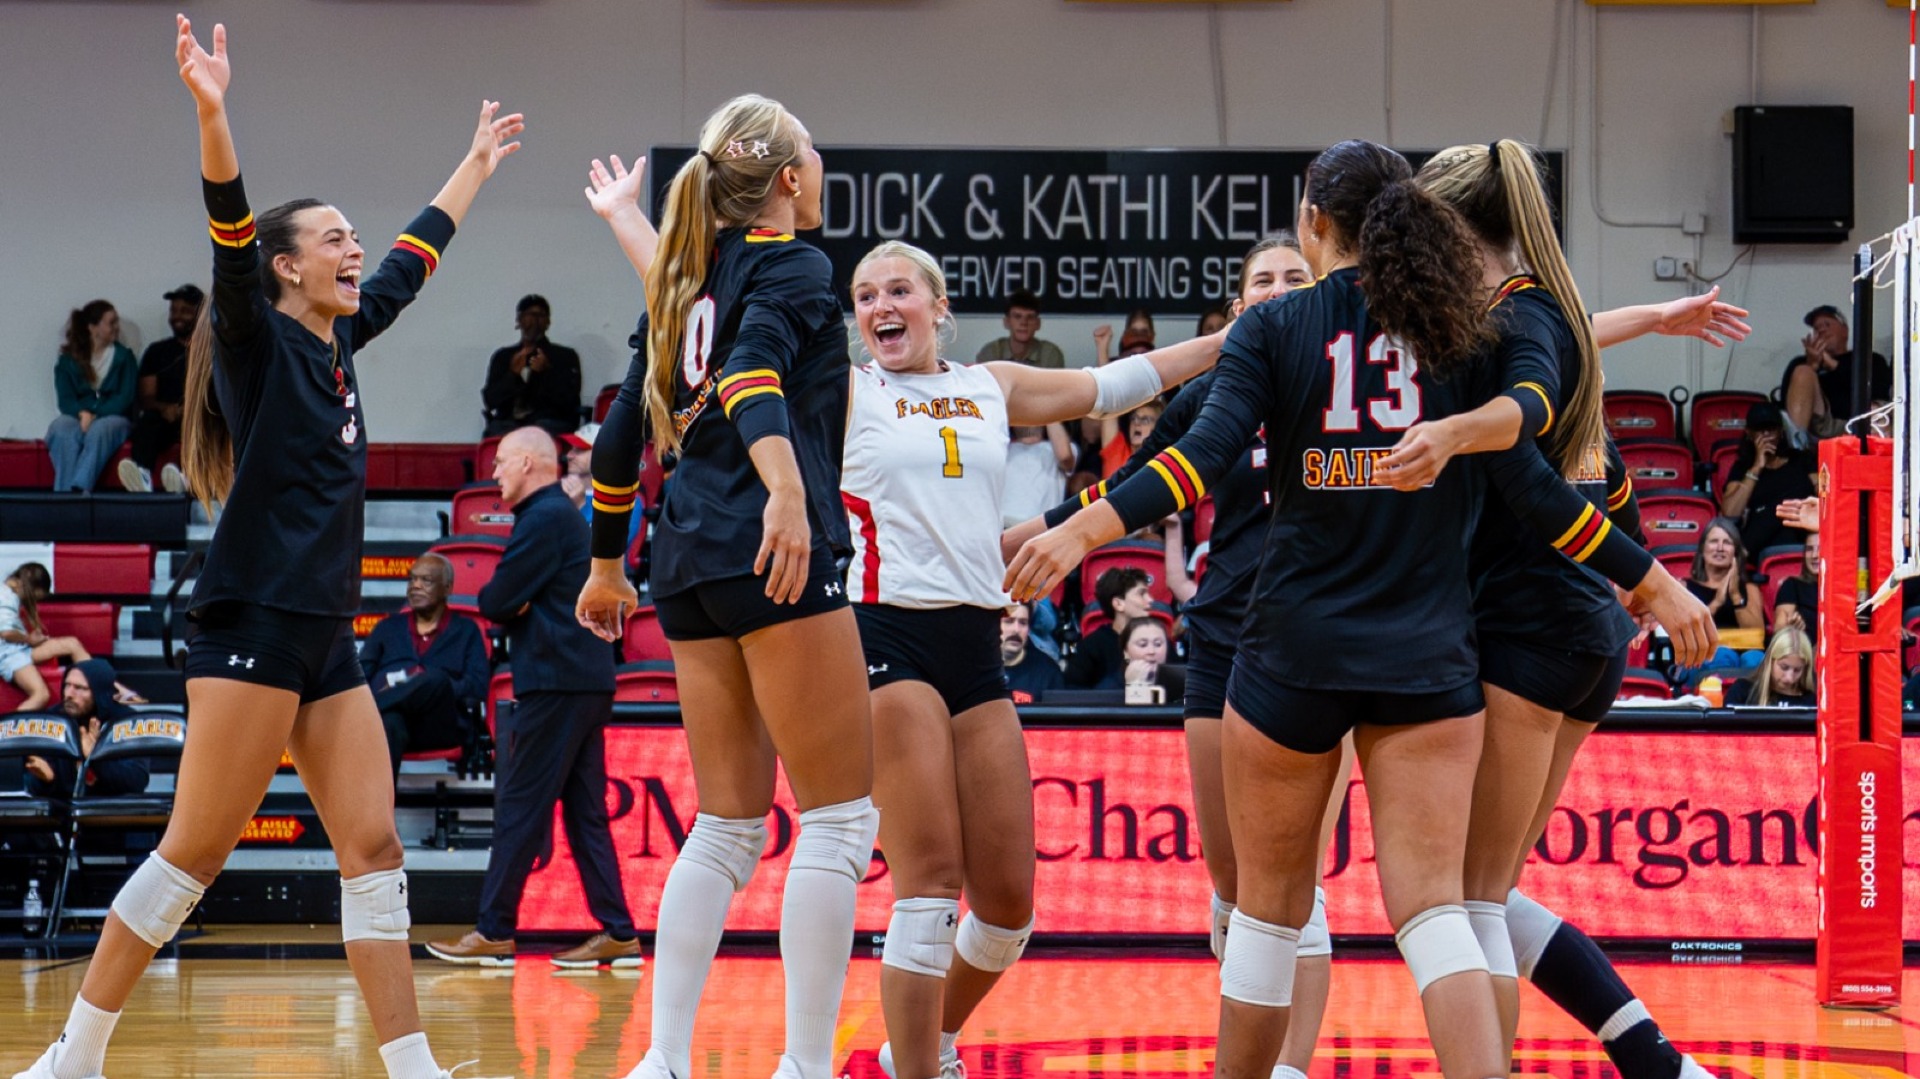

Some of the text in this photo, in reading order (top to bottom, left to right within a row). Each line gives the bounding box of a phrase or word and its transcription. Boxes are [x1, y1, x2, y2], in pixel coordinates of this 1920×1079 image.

[821, 173, 945, 239] DICK
[964, 174, 1004, 240] &
[1023, 174, 1167, 240] KATHI
[941, 255, 1045, 298] ERVED
[1057, 256, 1190, 299] SEATING
[683, 294, 716, 390] 0
[1322, 330, 1423, 433] 13
[939, 426, 963, 478] 1
[1857, 771, 1878, 908] sports imports
[1671, 942, 1742, 951] DAKTRONICS
